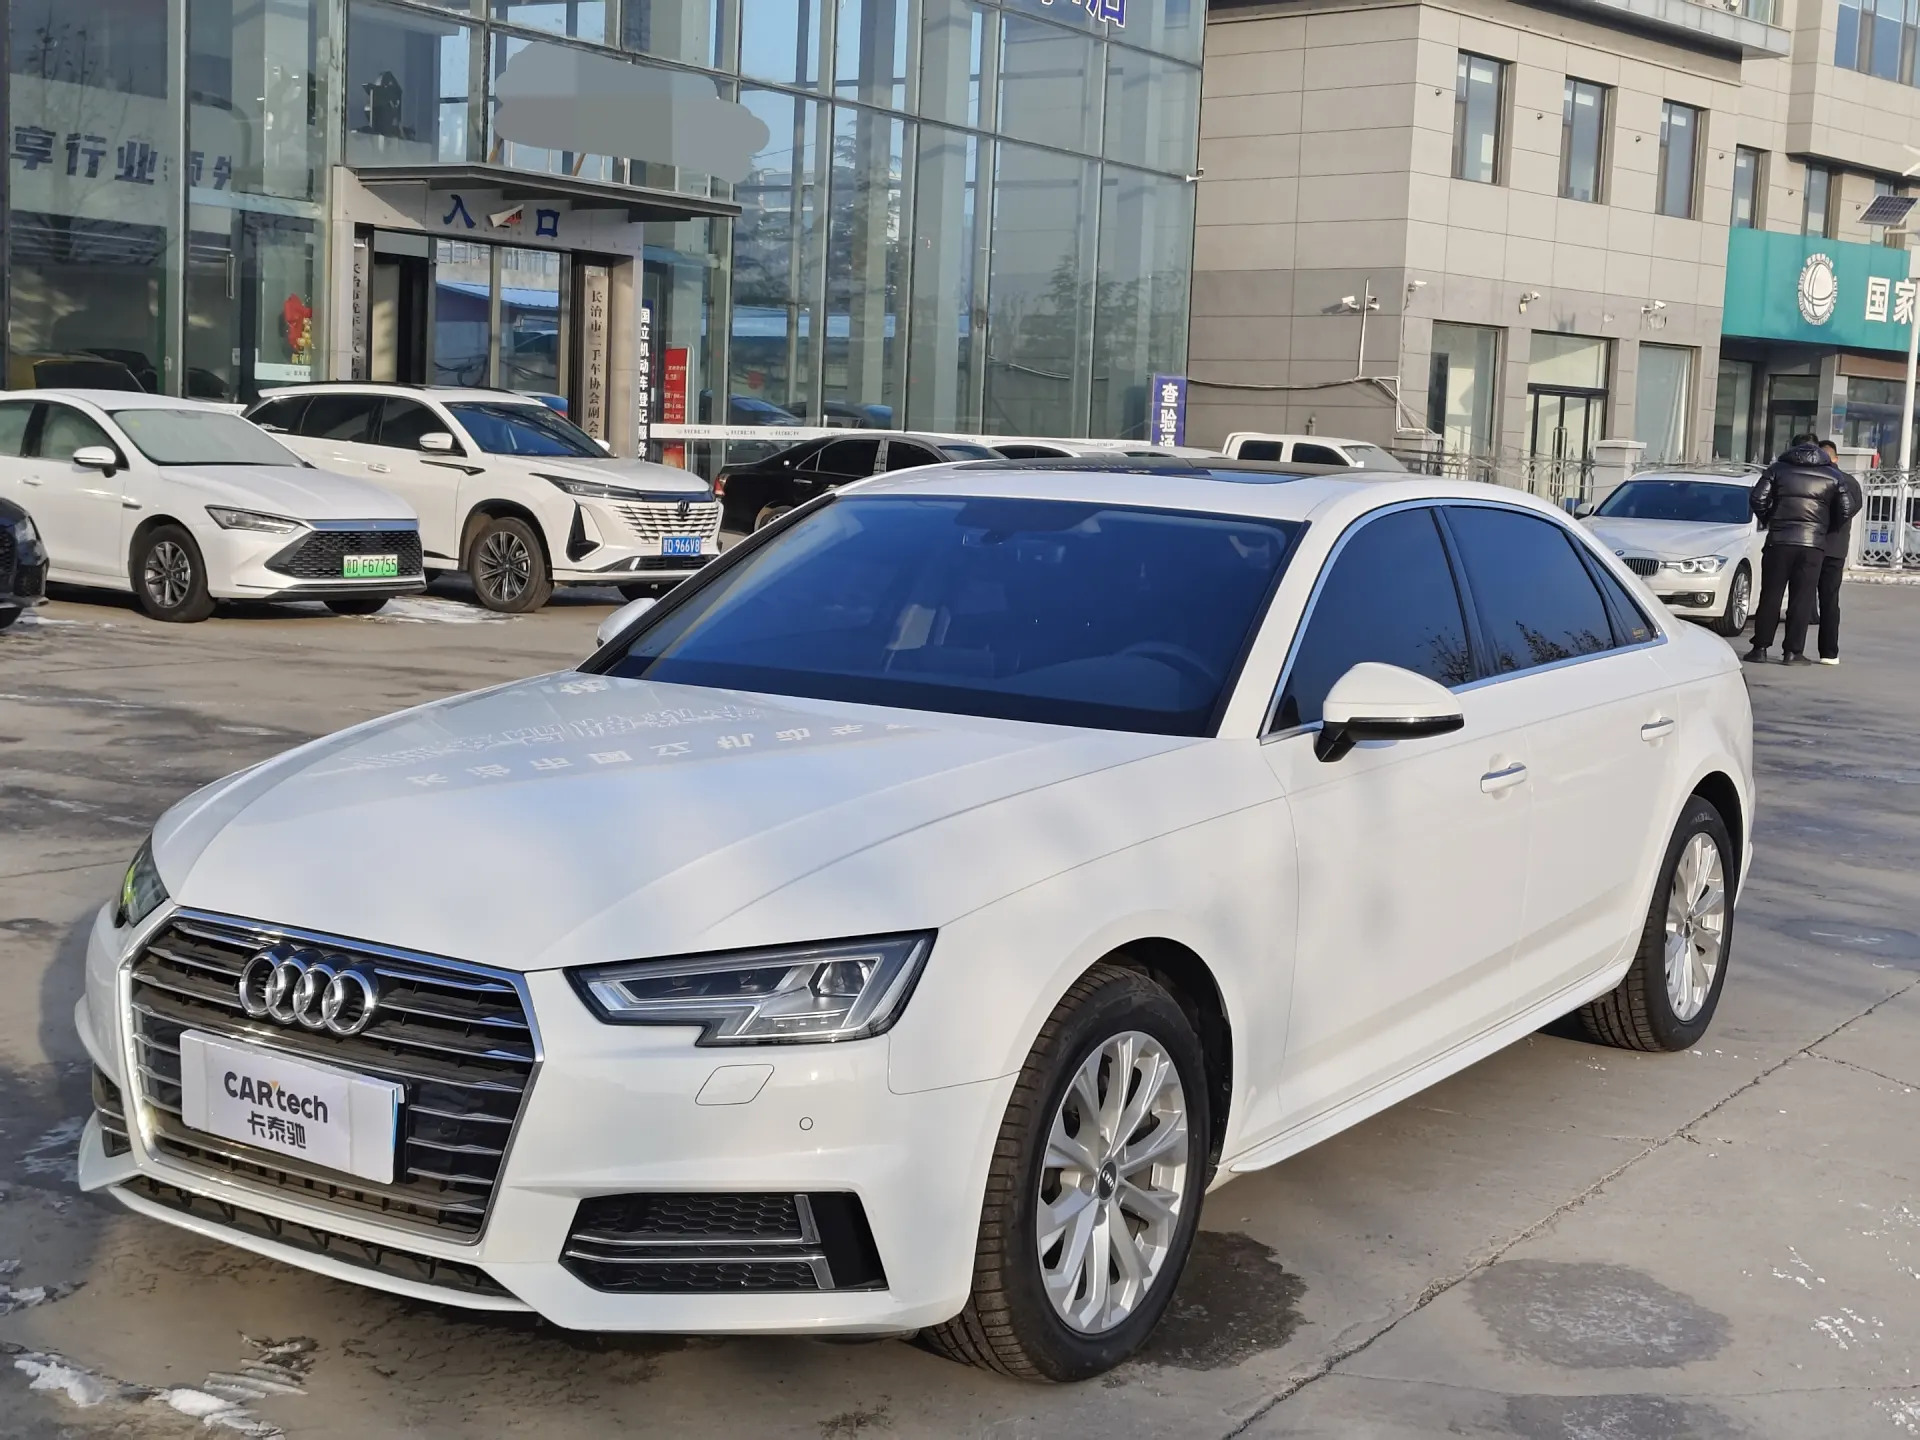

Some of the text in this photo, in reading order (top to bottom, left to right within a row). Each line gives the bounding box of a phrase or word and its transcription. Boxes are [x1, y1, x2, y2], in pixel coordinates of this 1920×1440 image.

[588, 289, 603, 441] 长治市二手车协会副会
[638, 308, 651, 463] 国立机动车登记服务
[224, 1071, 328, 1124] CARtech
[247, 1110, 307, 1150] 卡泰驰
